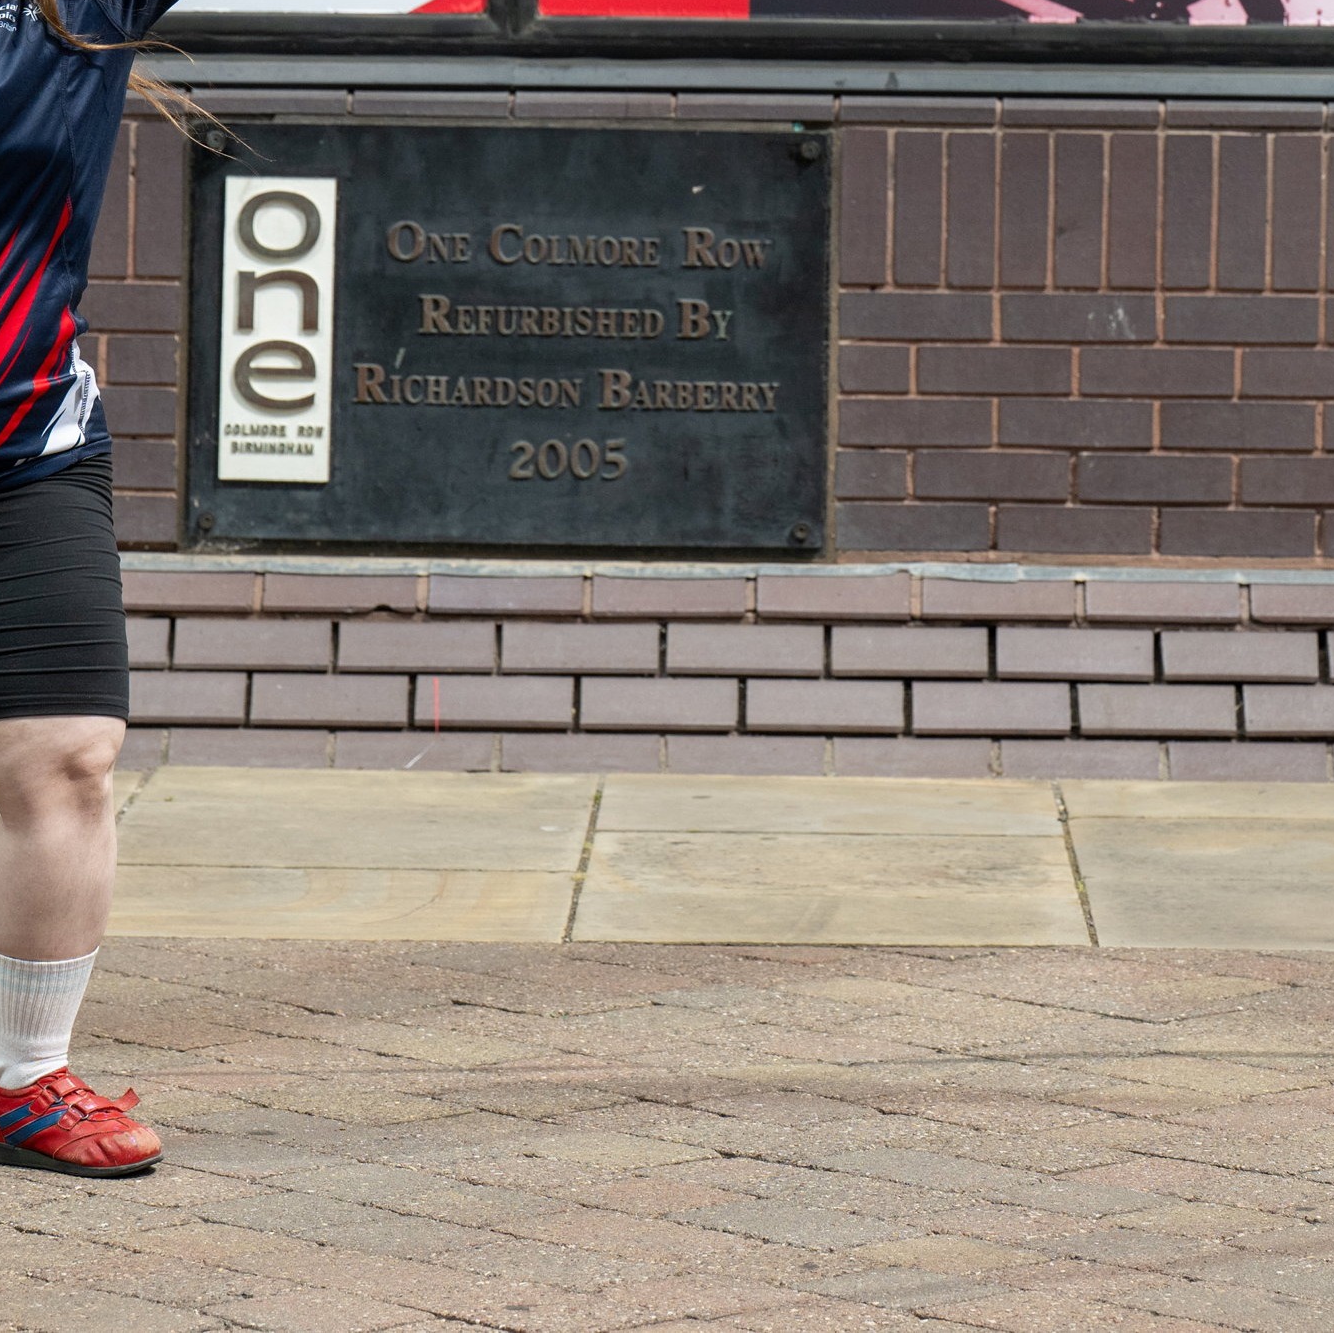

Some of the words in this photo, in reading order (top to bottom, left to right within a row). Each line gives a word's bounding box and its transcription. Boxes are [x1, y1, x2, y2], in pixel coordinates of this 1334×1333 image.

[232, 190, 321, 410] one
[224, 424, 286, 437] COLMORE
[297, 425, 324, 438] ROW
[230, 441, 314, 455] BIRMINGHAM
[509, 437, 628, 481] 2005
